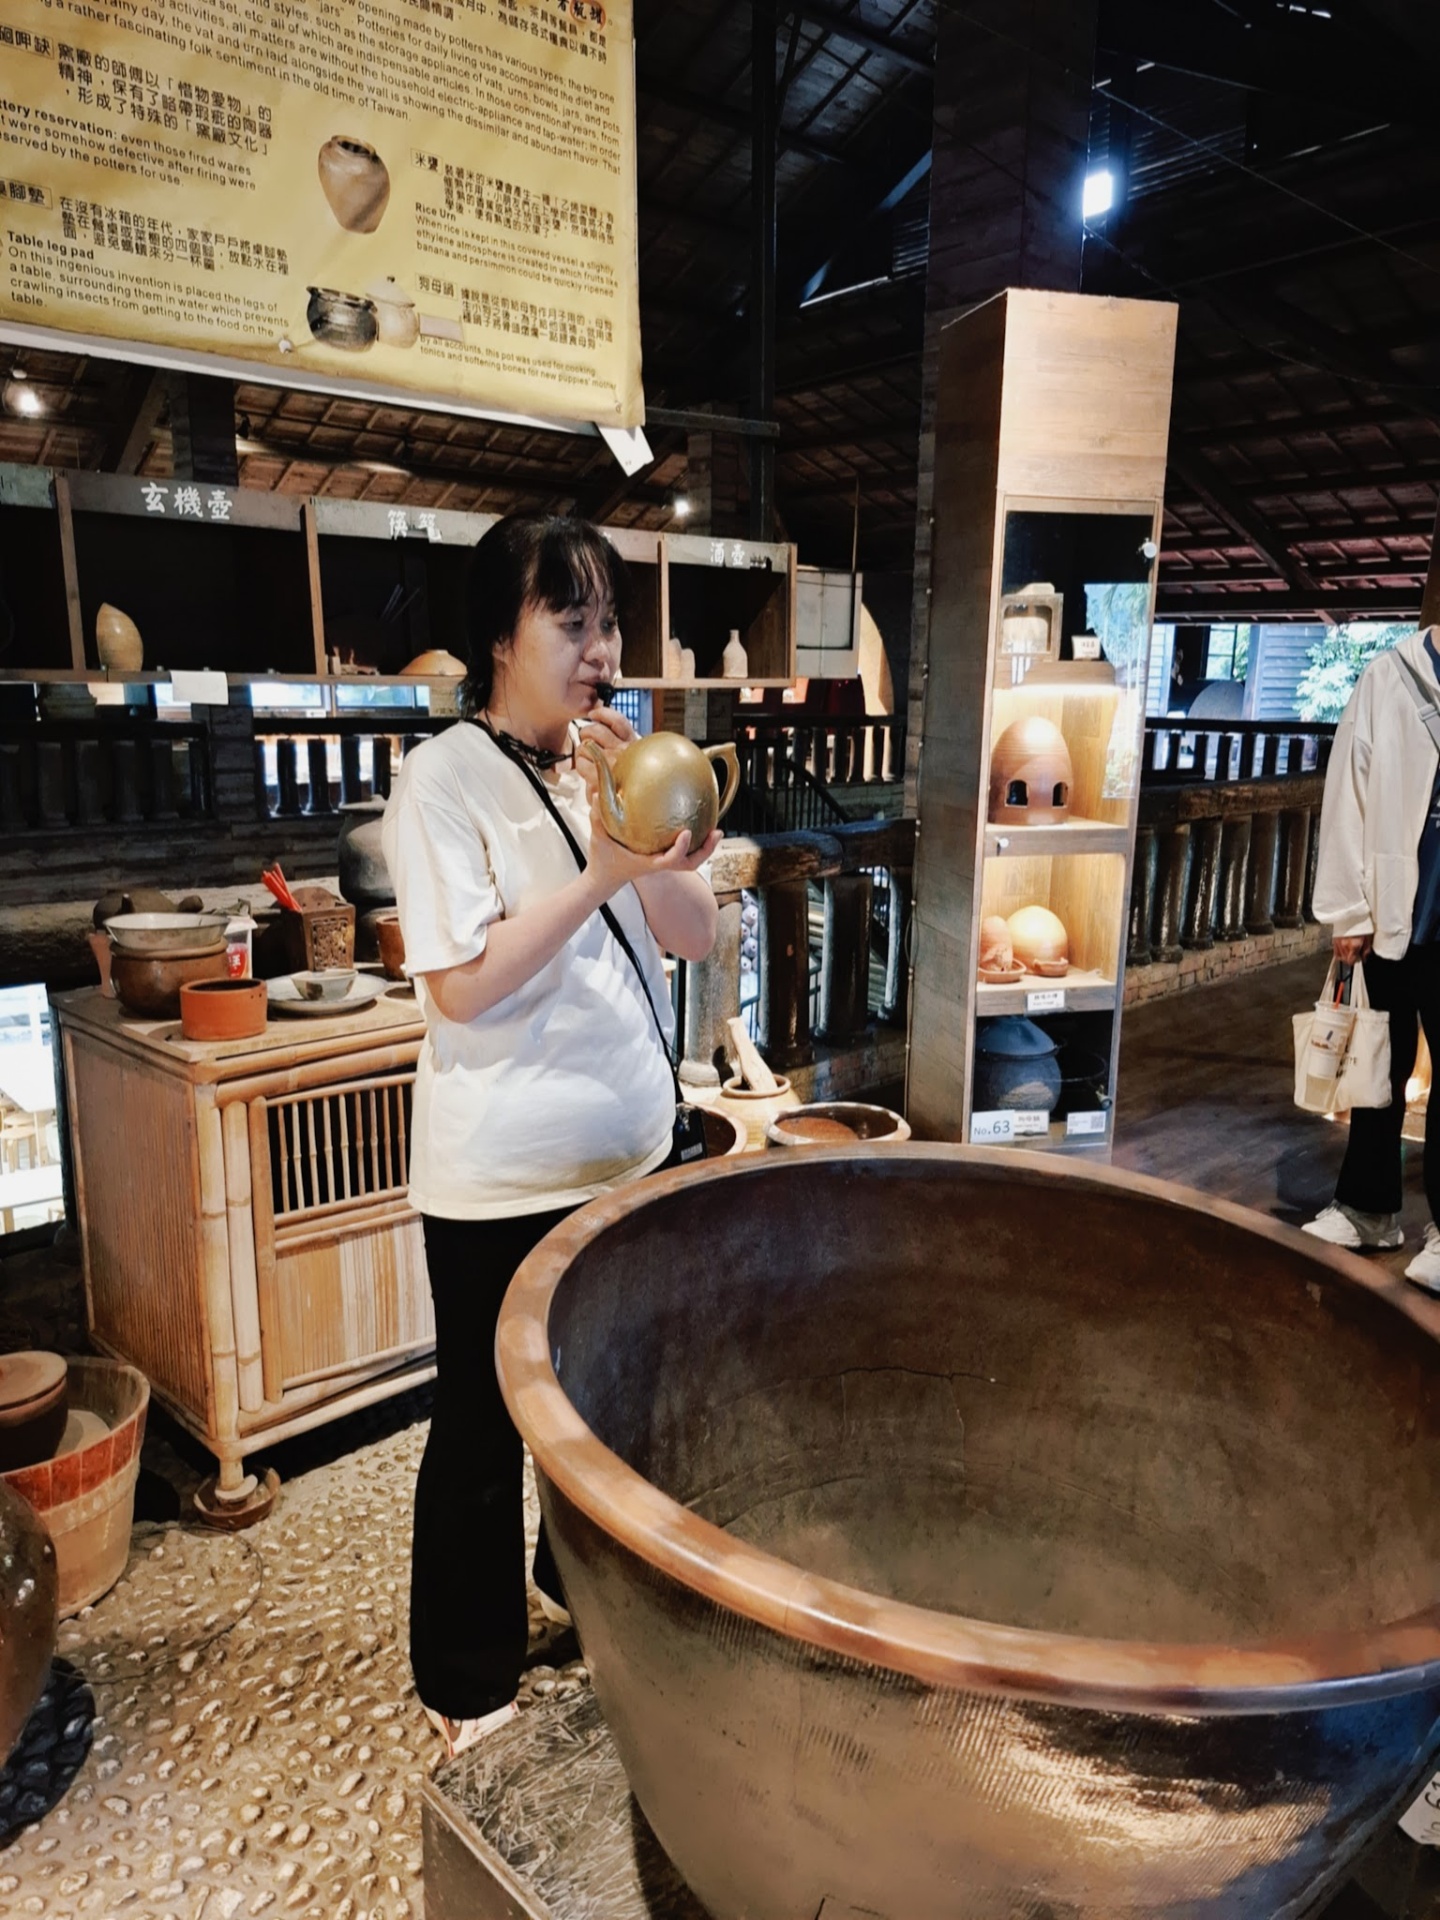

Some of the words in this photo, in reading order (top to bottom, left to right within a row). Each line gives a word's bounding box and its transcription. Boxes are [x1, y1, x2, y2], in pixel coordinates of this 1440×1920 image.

[68, 4, 109, 23] rather
[113, 15, 186, 49] fascinating
[189, 40, 212, 56] folk
[216, 52, 276, 77] sentiment
[292, 72, 310, 87] the
[313, 82, 328, 94] old
[332, 86, 355, 103] time
[372, 99, 411, 121] Taiwan.
[271, 19, 285, 30] all
[302, 30, 333, 45] which
[336, 43, 353, 54] are
[356, 46, 430, 80] indispensable
[486, 91, 510, 108] those
[513, 103, 570, 130] conventional
[601, 131, 619, 146] from
[315, 18, 340, 32] such
[359, 32, 374, 45] the
[378, 41, 423, 63] storage
[421, 56, 470, 79] appliance
[584, 114, 600, 126] and
[357, 14, 405, 37] Potteries
[408, 31, 421, 43] for
[424, 36, 448, 55] daily
[450, 45, 477, 65] living
[479, 58, 496, 70] use
[499, 66, 558, 94] accompanied
[560, 87, 573, 100] the
[575, 93, 592, 108] diet
[594, 103, 609, 115] and
[358, 3, 400, 25] opening
[403, 19, 432, 34] made
[449, 35, 483, 53] potters
[485, 47, 502, 61] has
[505, 56, 536, 73] various
[568, 78, 581, 91] the
[583, 84, 596, 100] big
[599, 92, 614, 103] one
[141, 7, 168, 26] day,
[171, 17, 191, 32] the
[195, 28, 213, 40] vat
[217, 36, 239, 48] and
[243, 44, 262, 56] urn
[266, 48, 287, 64] laid
[290, 59, 344, 83] alongside
[347, 76, 364, 89] the
[366, 85, 388, 98] wall
[402, 96, 444, 119] showing
[447, 108, 462, 122] the
[465, 114, 509, 137] dissimilar
[511, 132, 527, 144] and
[530, 138, 571, 158] abundant
[603, 159, 620, 174] That
[232, 23, 246, 34] all
[249, 30, 295, 49] matters
[298, 46, 316, 57] are
[320, 53, 358, 72] without
[361, 64, 377, 78] the
[381, 71, 434, 97] household
[437, 91, 522, 127] electric-appliance
[524, 122, 541, 133] and
[599, 147, 620, 160] order
[9, 120, 40, 133] were
[44, 129, 105, 149] somehow
[108, 143, 164, 165] defective
[167, 160, 193, 173] after
[197, 165, 225, 184] firing
[228, 176, 255, 188] were
[34, 110, 116, 139] reservation:
[121, 134, 150, 148] even
[153, 140, 185, 158] those
[188, 149, 214, 165] fired
[217, 160, 250, 175] wares
[51, 143, 67, 158] by
[70, 147, 90, 161] the
[93, 156, 136, 173] potters
[140, 165, 156, 178] for
[159, 173, 183, 186] use.
[415, 201, 436, 215] Rice
[439, 208, 455, 220] Urn
[7, 231, 43, 247] Table
[47, 240, 66, 255] leg
[70, 248, 94, 259] pad
[415, 214, 442, 229] When
[444, 223, 459, 234] rice
[471, 230, 488, 245] kept
[500, 238, 514, 249] this
[517, 245, 549, 258] covered
[551, 254, 577, 265] vessel
[587, 261, 613, 276] slightly
[416, 229, 454, 245] ethylene
[457, 240, 505, 259] atmosphere
[517, 257, 548, 269] created
[559, 266, 581, 278] which
[584, 271, 603, 283] fruits
[416, 241, 449, 256] banana
[452, 252, 467, 261] and
[469, 257, 516, 273] persimmon
[517, 269, 540, 279] could
[553, 277, 581, 292] quickly
[584, 283, 613, 297] ripened
[8, 246, 27, 258] On
[30, 251, 52, 264] this
[56, 256, 114, 278] ingenious
[118, 270, 170, 290] invention
[185, 285, 221, 300] placed
[224, 292, 240, 304] the
[243, 296, 265, 311] legs
[10, 279, 62, 298] crawling
[66, 287, 109, 304] insects
[112, 296, 138, 310] from
[141, 305, 180, 321] getting
[196, 313, 213, 325] the
[216, 316, 239, 329] food
[242, 324, 255, 333] on
[257, 324, 273, 336] the
[59, 274, 130, 298] surrounding
[133, 287, 162, 301] them
[177, 298, 208, 310] water
[211, 304, 241, 317] which
[244, 312, 288, 326] prevents
[140, 481, 234, 521] 玄機壺
[973, 1119, 1011, 1136] No.63
